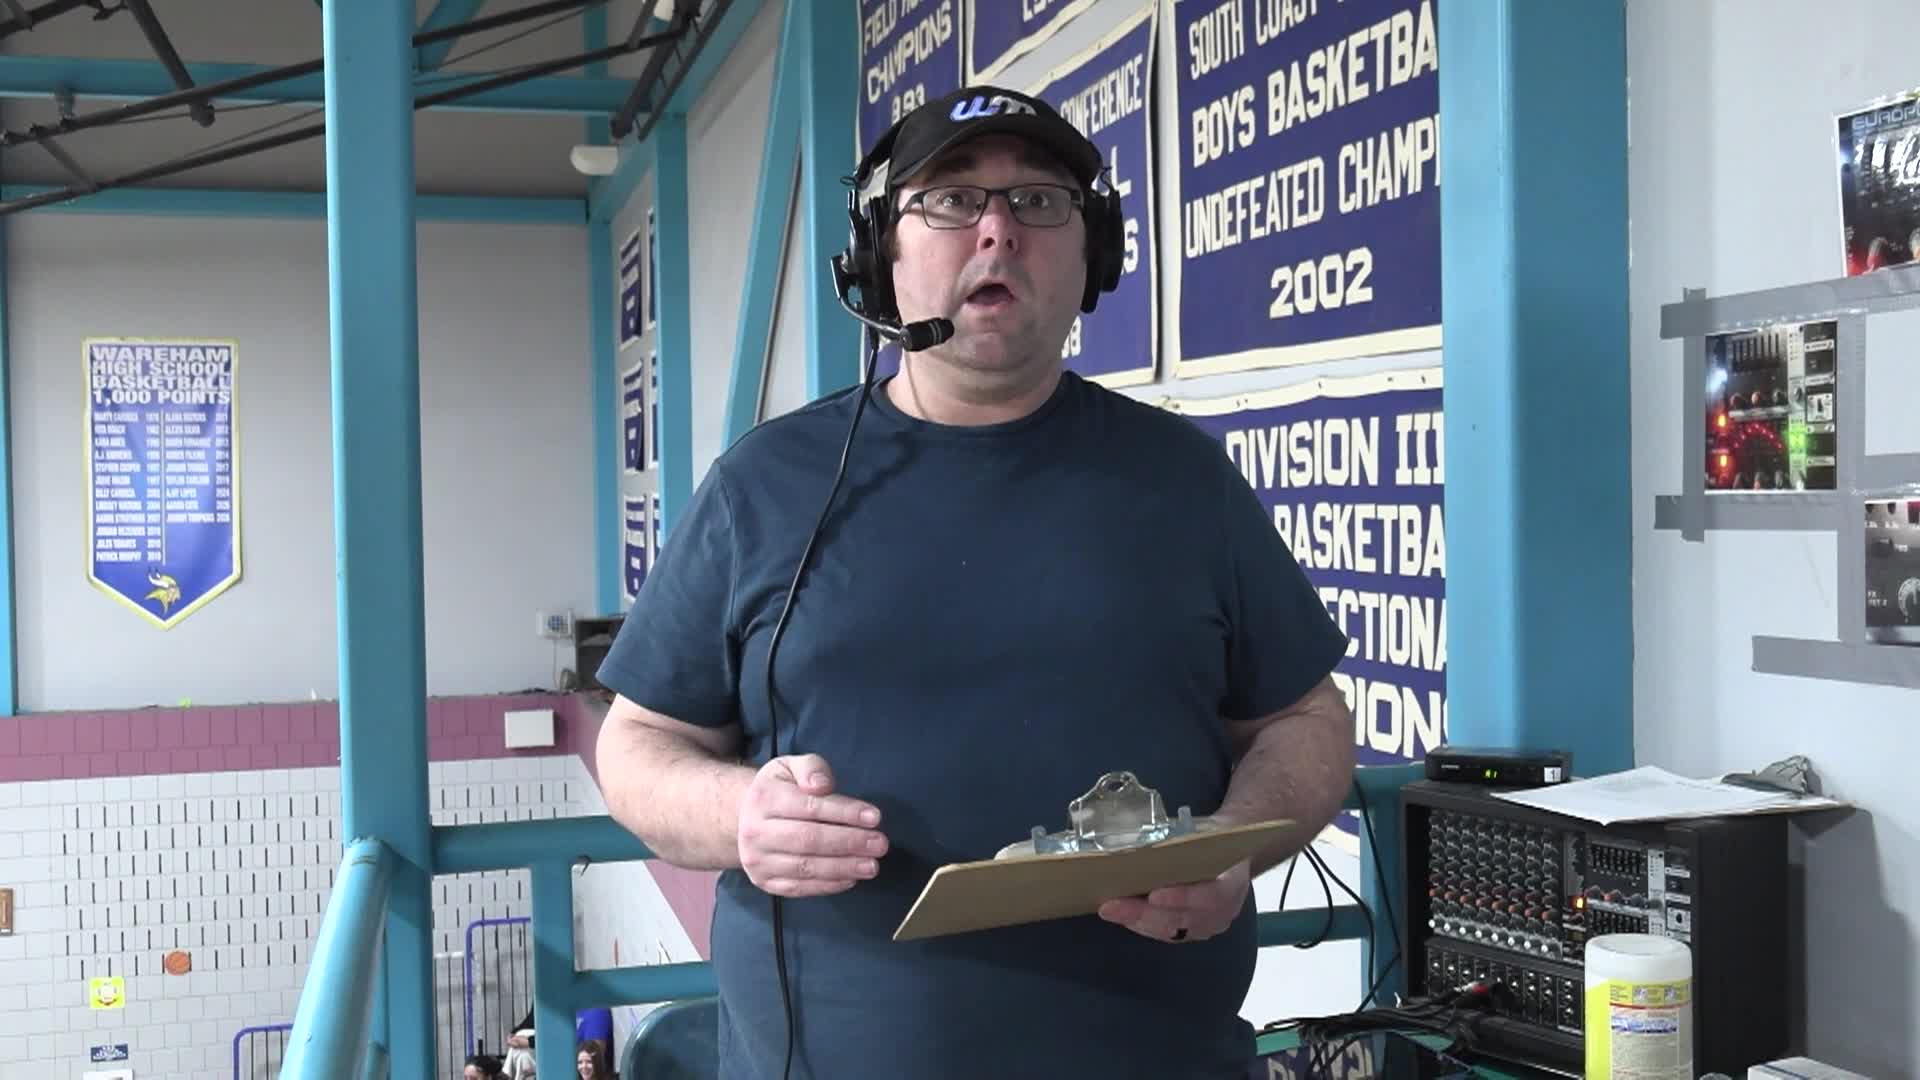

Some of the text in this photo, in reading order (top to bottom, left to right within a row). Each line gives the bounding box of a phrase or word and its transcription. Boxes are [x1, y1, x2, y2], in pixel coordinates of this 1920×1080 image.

[864, 0, 897, 56] FIELD
[867, 0, 951, 105] CHAMPIONS
[1189, 1, 1245, 80] SOUTH
[1060, 53, 1143, 139] CONFERENCE
[1192, 0, 1439, 168] BOYS BASKETBA
[1185, 156, 1325, 259] UNDEFEATED
[1269, 246, 1373, 319] 2002
[92, 347, 229, 361] WAREHAM
[92, 361, 230, 377] HIGH SCHOOL
[92, 375, 230, 390] BASKETBALL
[93, 390, 230, 406] 1,000 POINTS
[1226, 416, 1379, 490] DIVISION
